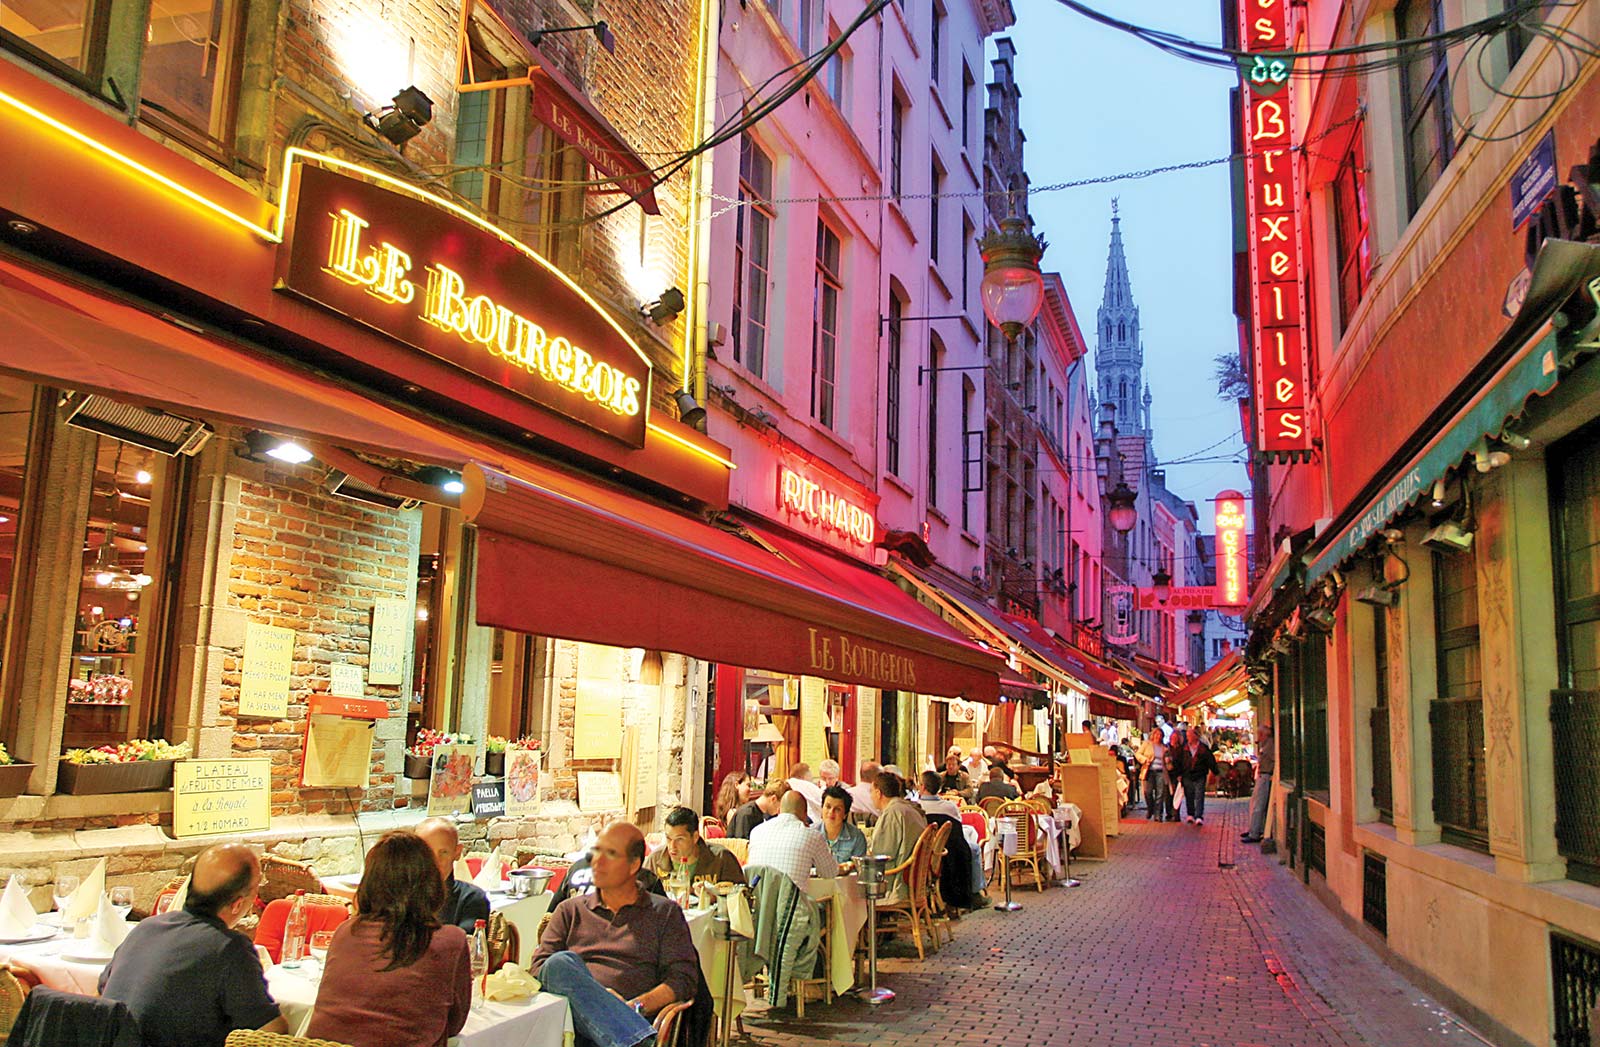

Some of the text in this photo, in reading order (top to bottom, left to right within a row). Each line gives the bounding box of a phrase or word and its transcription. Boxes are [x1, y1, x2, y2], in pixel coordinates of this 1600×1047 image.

[1251, 55, 1288, 82] de
[551, 102, 573, 136] LE
[1252, 100, 1302, 439] Bruxelles
[322, 208, 641, 417] LE BOURGEOIS
[783, 469, 875, 544] RICHARD
[807, 627, 917, 687] LE BOURGEOIS
[196, 765, 249, 777] PLATEAU
[226, 779, 237, 789] DE
[241, 777, 264, 788] MER
[476, 787, 500, 799] PAELLA
[212, 817, 250, 830] HOMARD
